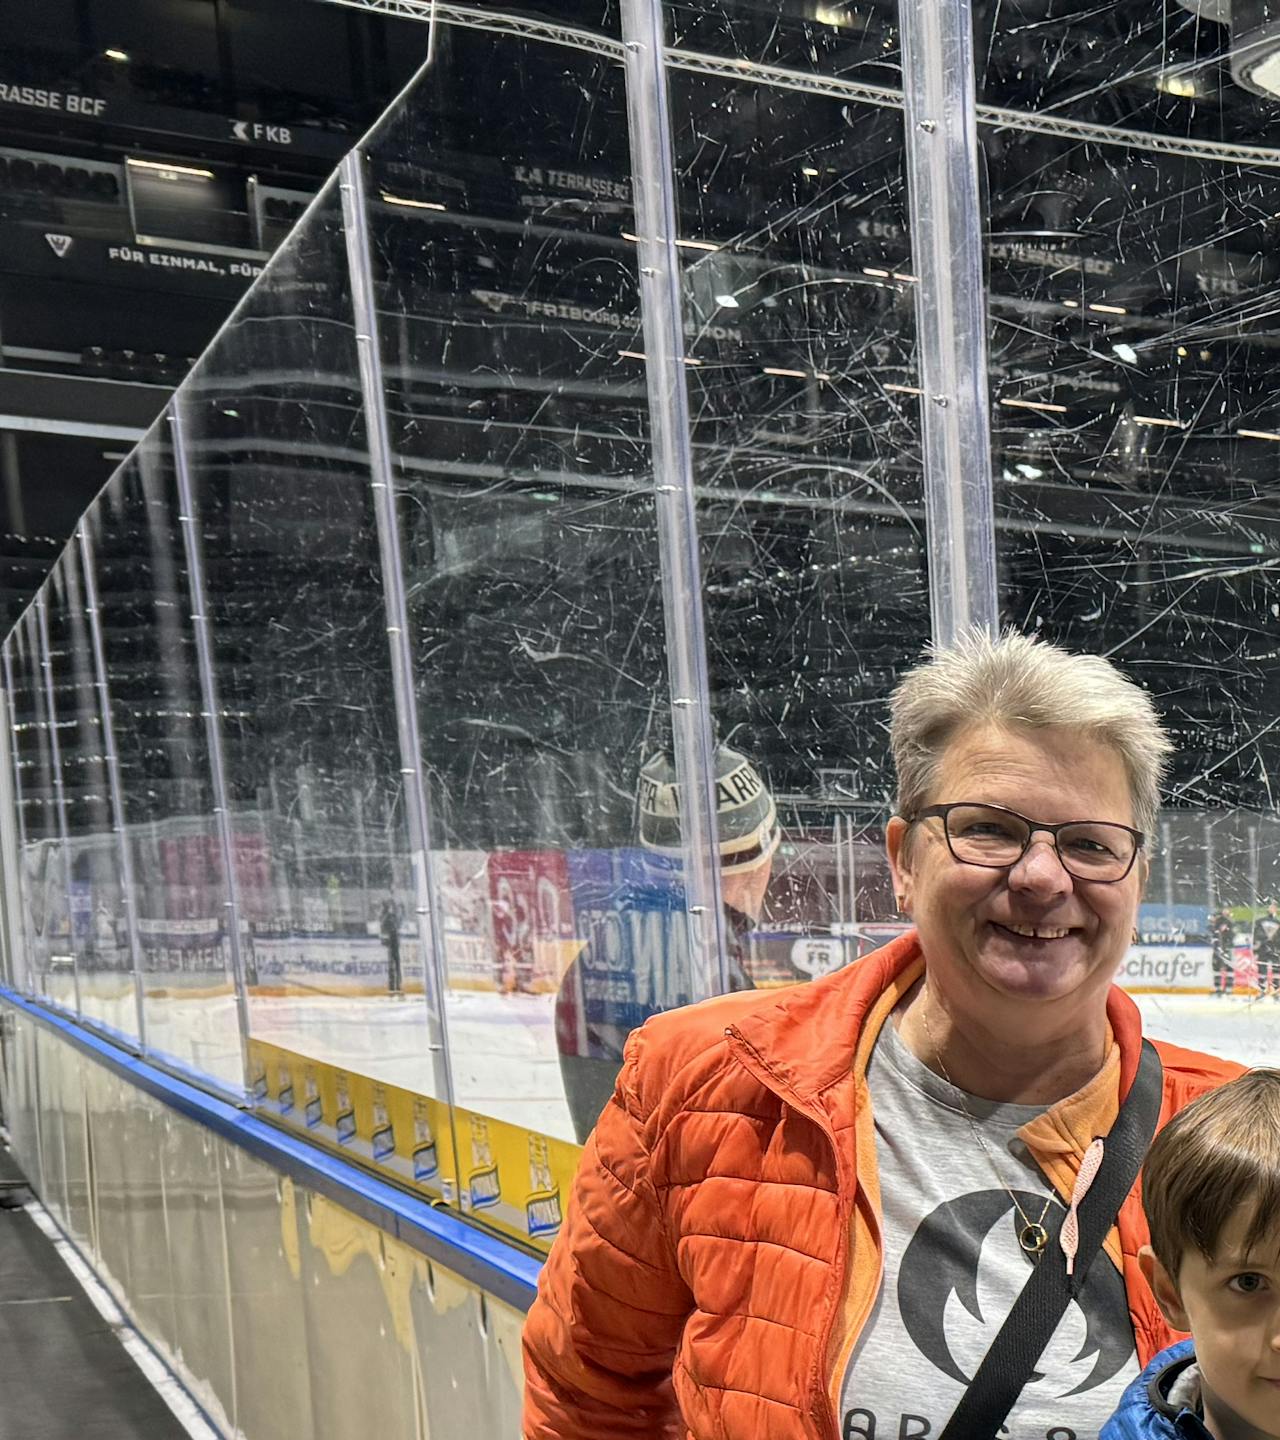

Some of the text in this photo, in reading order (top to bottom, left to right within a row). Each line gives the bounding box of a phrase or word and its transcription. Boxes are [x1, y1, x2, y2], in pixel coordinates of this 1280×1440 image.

[66, 95, 107, 116] BCF
[253, 123, 292, 144] FKB
[109, 247, 145, 264] FÜR
[150, 252, 226, 276] EINMAL,
[1126, 953, 1204, 983] chafer
